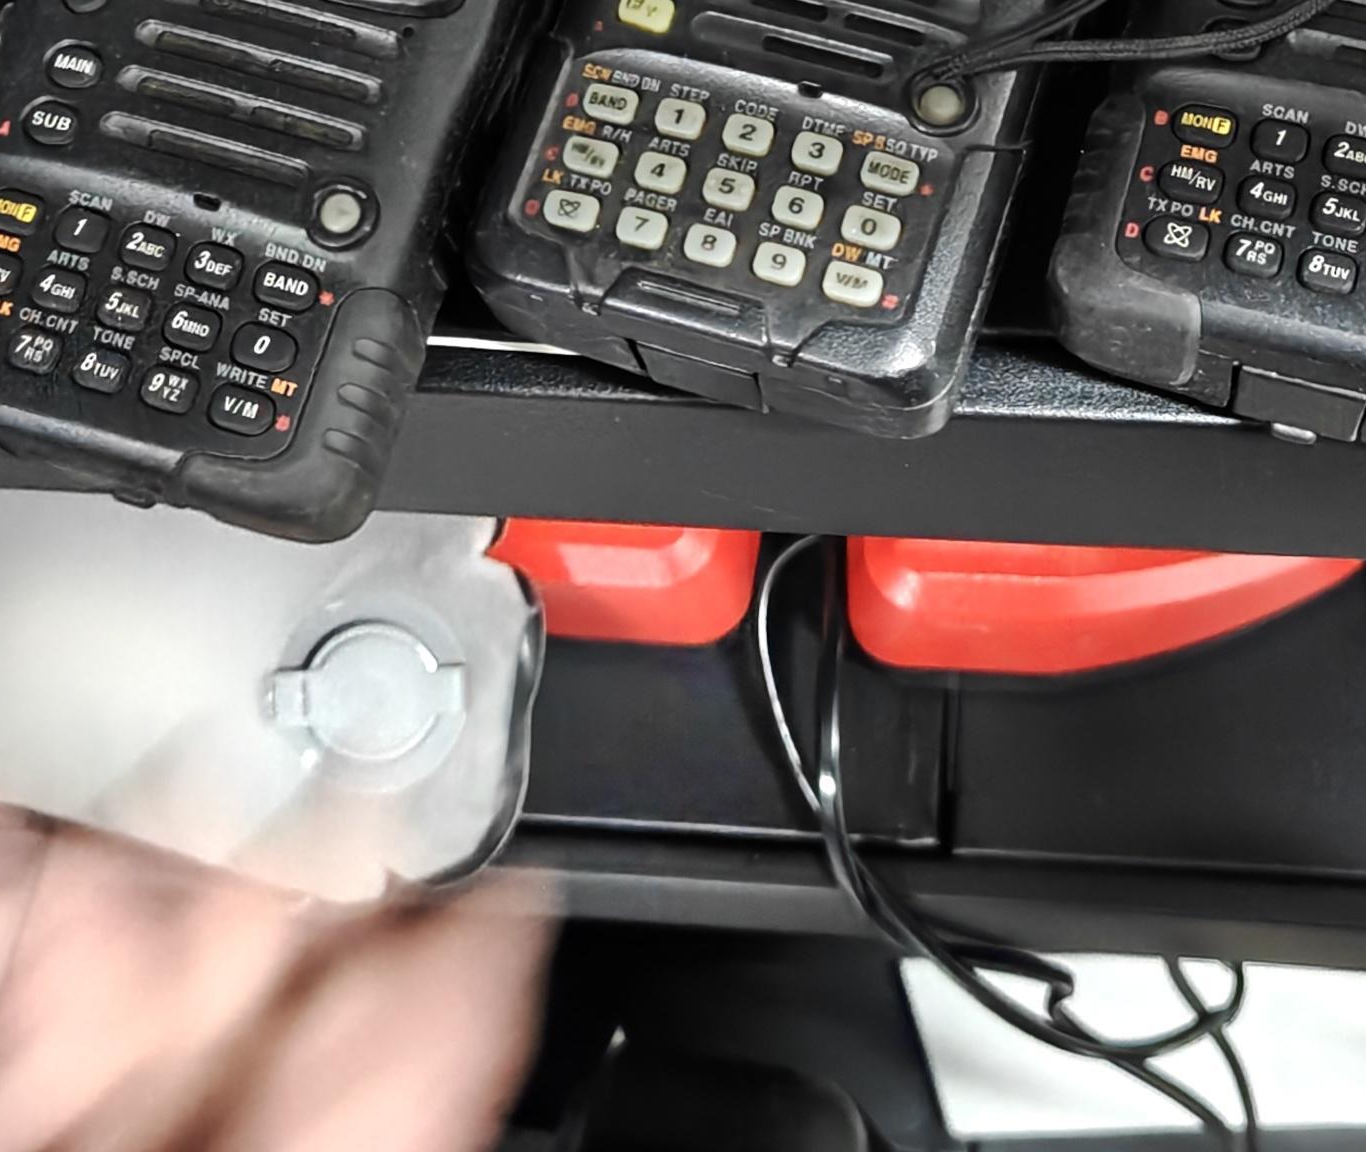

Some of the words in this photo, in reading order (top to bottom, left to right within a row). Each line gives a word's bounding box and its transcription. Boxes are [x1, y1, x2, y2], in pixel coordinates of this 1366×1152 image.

[54, 54, 96, 76] MAIN
[589, 92, 627, 110] BAND
[670, 83, 710, 101] STEP
[674, 109, 684, 124] 1
[735, 99, 779, 121] CODE
[1262, 104, 1309, 124] SCAN
[32, 111, 71, 131] SUB
[738, 124, 757, 141] 2
[1276, 130, 1287, 146] 1
[648, 137, 691, 157] ARTS
[808, 142, 825, 159] 3
[910, 143, 939, 162] TYP
[1180, 145, 1219, 163] EMG
[650, 163, 666, 177] 4
[867, 160, 911, 185] MODE
[1140, 166, 1154, 181] C
[1171, 164, 1216, 192] HM/RV
[1250, 160, 1295, 179] ARTS
[542, 168, 565, 184] LK
[592, 179, 612, 195] PO
[719, 178, 735, 194] 5
[787, 171, 824, 191] RPT
[68, 190, 113, 212] SCAN
[624, 187, 677, 211] PAGER
[788, 197, 805, 214] 6
[862, 192, 899, 213] SET
[143, 210, 171, 228] DW
[703, 208, 733, 227] EAI
[1147, 197, 1167, 212] TX
[1171, 203, 1193, 217] PO
[1198, 207, 1222, 224] LK
[73, 219, 87, 236] 1
[635, 216, 649, 231] 7
[860, 218, 877, 236] 0
[1230, 214, 1296, 239] CH.CNT
[211, 227, 237, 247] WX
[701, 234, 717, 251] 8
[758, 222, 780, 238] SP
[783, 231, 817, 249] BNK
[1312, 231, 1359, 253] TONE
[47, 250, 90, 270] ARTS
[265, 242, 300, 264] BND
[301, 255, 326, 273] DN
[771, 253, 787, 270] 9
[832, 243, 863, 261] DW
[866, 251, 894, 270] MT
[111, 266, 160, 290] S.SCH
[263, 272, 309, 296] BAND
[174, 284, 230, 310] SP-ANA
[258, 308, 293, 328] SET
[93, 328, 135, 350] TONE
[253, 336, 271, 355] 0
[159, 347, 200, 370] SPCL
[216, 362, 268, 389] WRITE
[271, 378, 298, 396] MT
[224, 396, 259, 419] V/M
